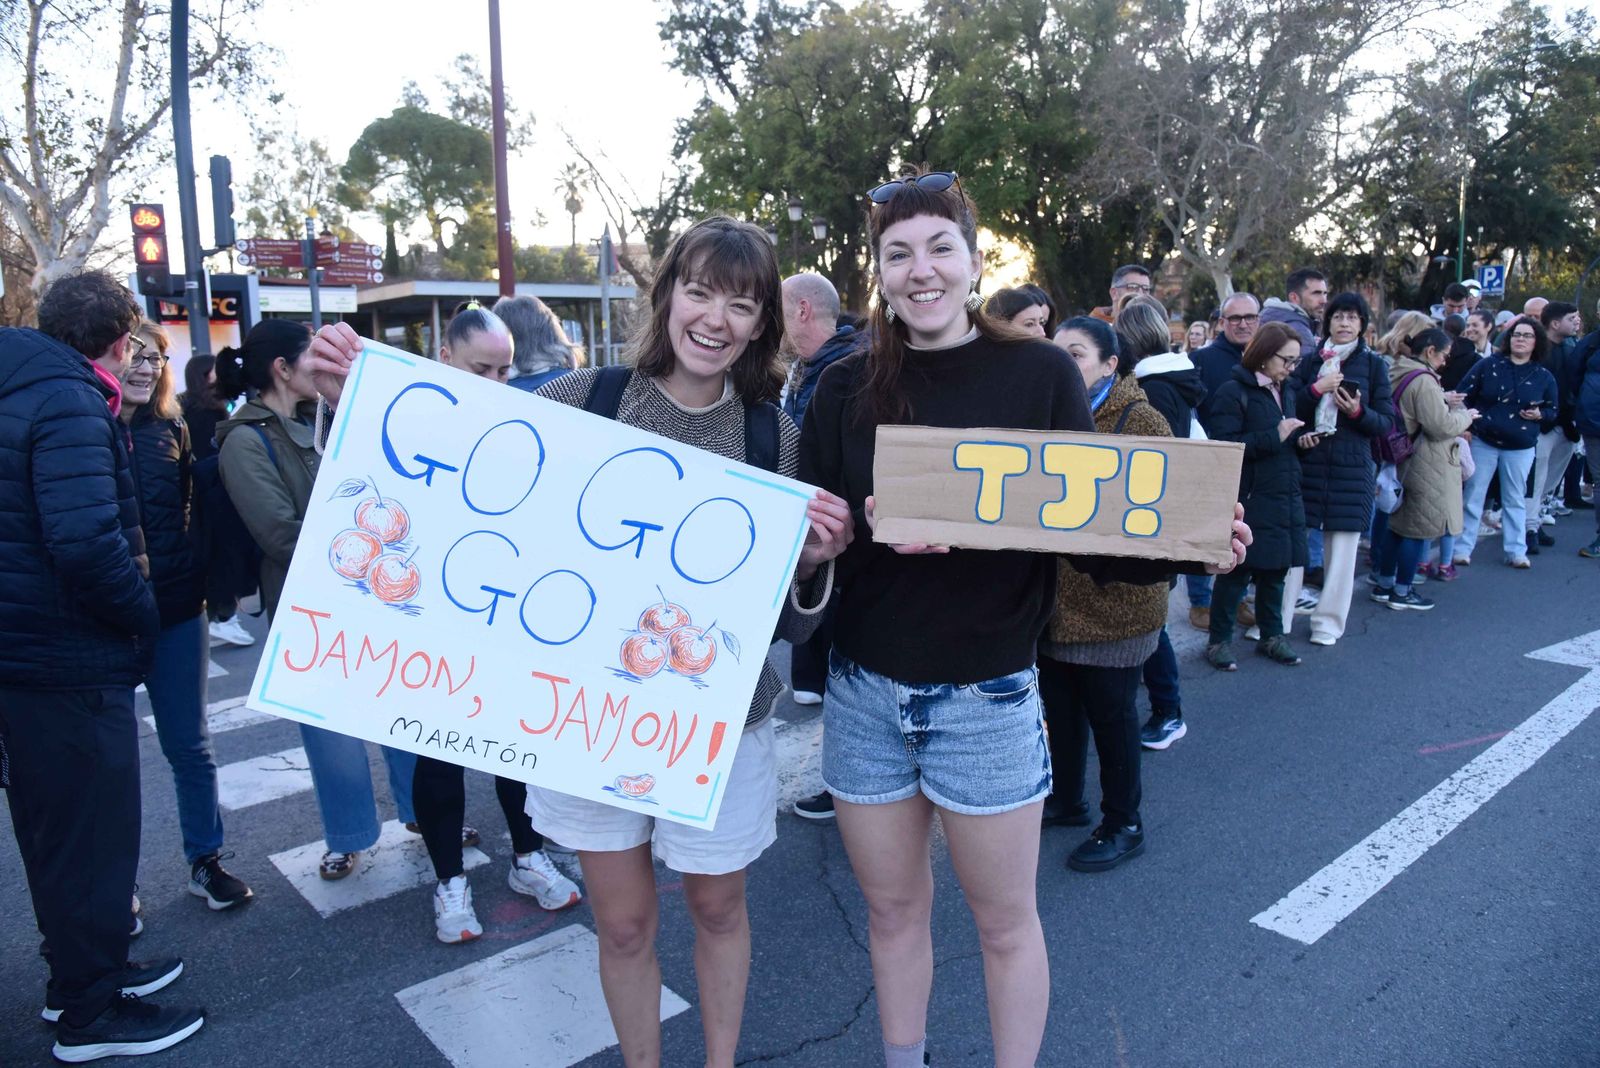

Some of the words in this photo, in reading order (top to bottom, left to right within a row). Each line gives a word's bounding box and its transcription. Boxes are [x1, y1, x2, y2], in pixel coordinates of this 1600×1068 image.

[382, 382, 545, 516] GO
[577, 447, 756, 584] GO
[953, 440, 1168, 538] TJ!
[441, 530, 597, 646] GO
[284, 605, 481, 718] JAMON,
[519, 670, 727, 785] JAMON!
